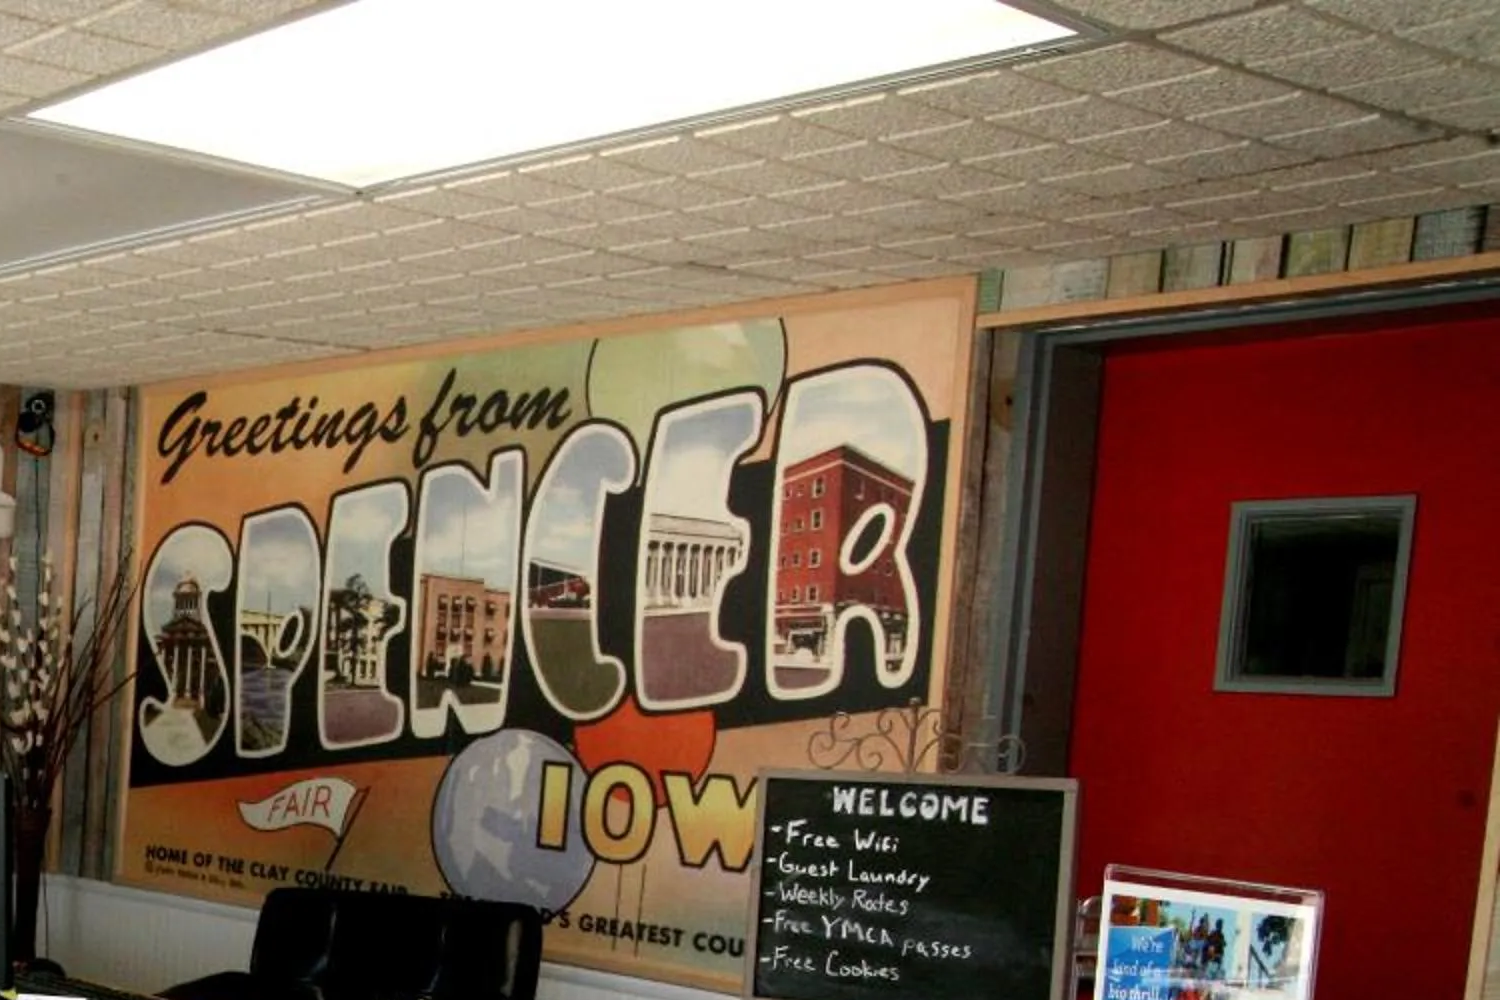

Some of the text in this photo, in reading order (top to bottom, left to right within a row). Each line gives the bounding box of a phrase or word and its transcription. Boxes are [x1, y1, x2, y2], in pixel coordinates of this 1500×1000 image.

[156, 367, 573, 485] Greetings from
[138, 358, 932, 770] SPENCER
[266, 784, 333, 823] FAIR
[536, 760, 758, 873] IOW
[831, 785, 990, 825] WELCOME
[145, 845, 188, 865] HOME
[193, 851, 213, 868] OF
[218, 855, 245, 875] THE
[249, 861, 290, 881] CLAY
[848, 860, 931, 893] Laundry
[578, 913, 687, 948] GREATEST
[692, 931, 745, 958] COU
[821, 916, 894, 948] YMCA
[825, 952, 900, 981] Cookies
